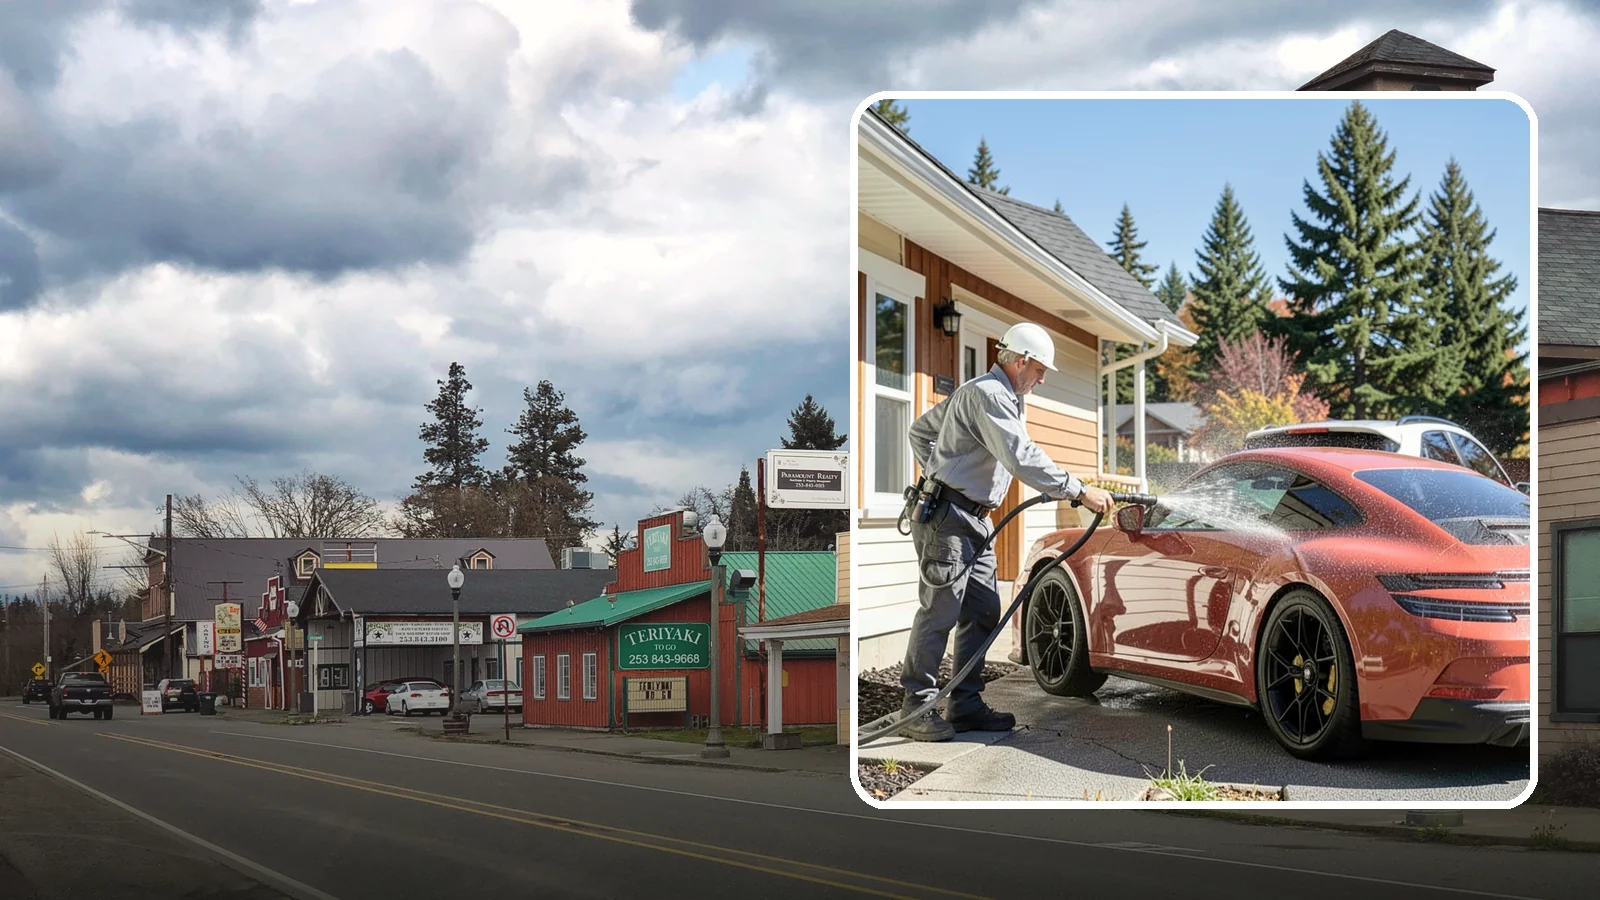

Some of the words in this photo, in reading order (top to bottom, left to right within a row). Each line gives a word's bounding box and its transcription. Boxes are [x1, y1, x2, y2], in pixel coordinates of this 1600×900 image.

[624, 627, 702, 646] TERIYAKI
[629, 654, 648, 664] 253
[652, 654, 700, 664] 843-9668
[639, 681, 672, 690] TERIYAKI
